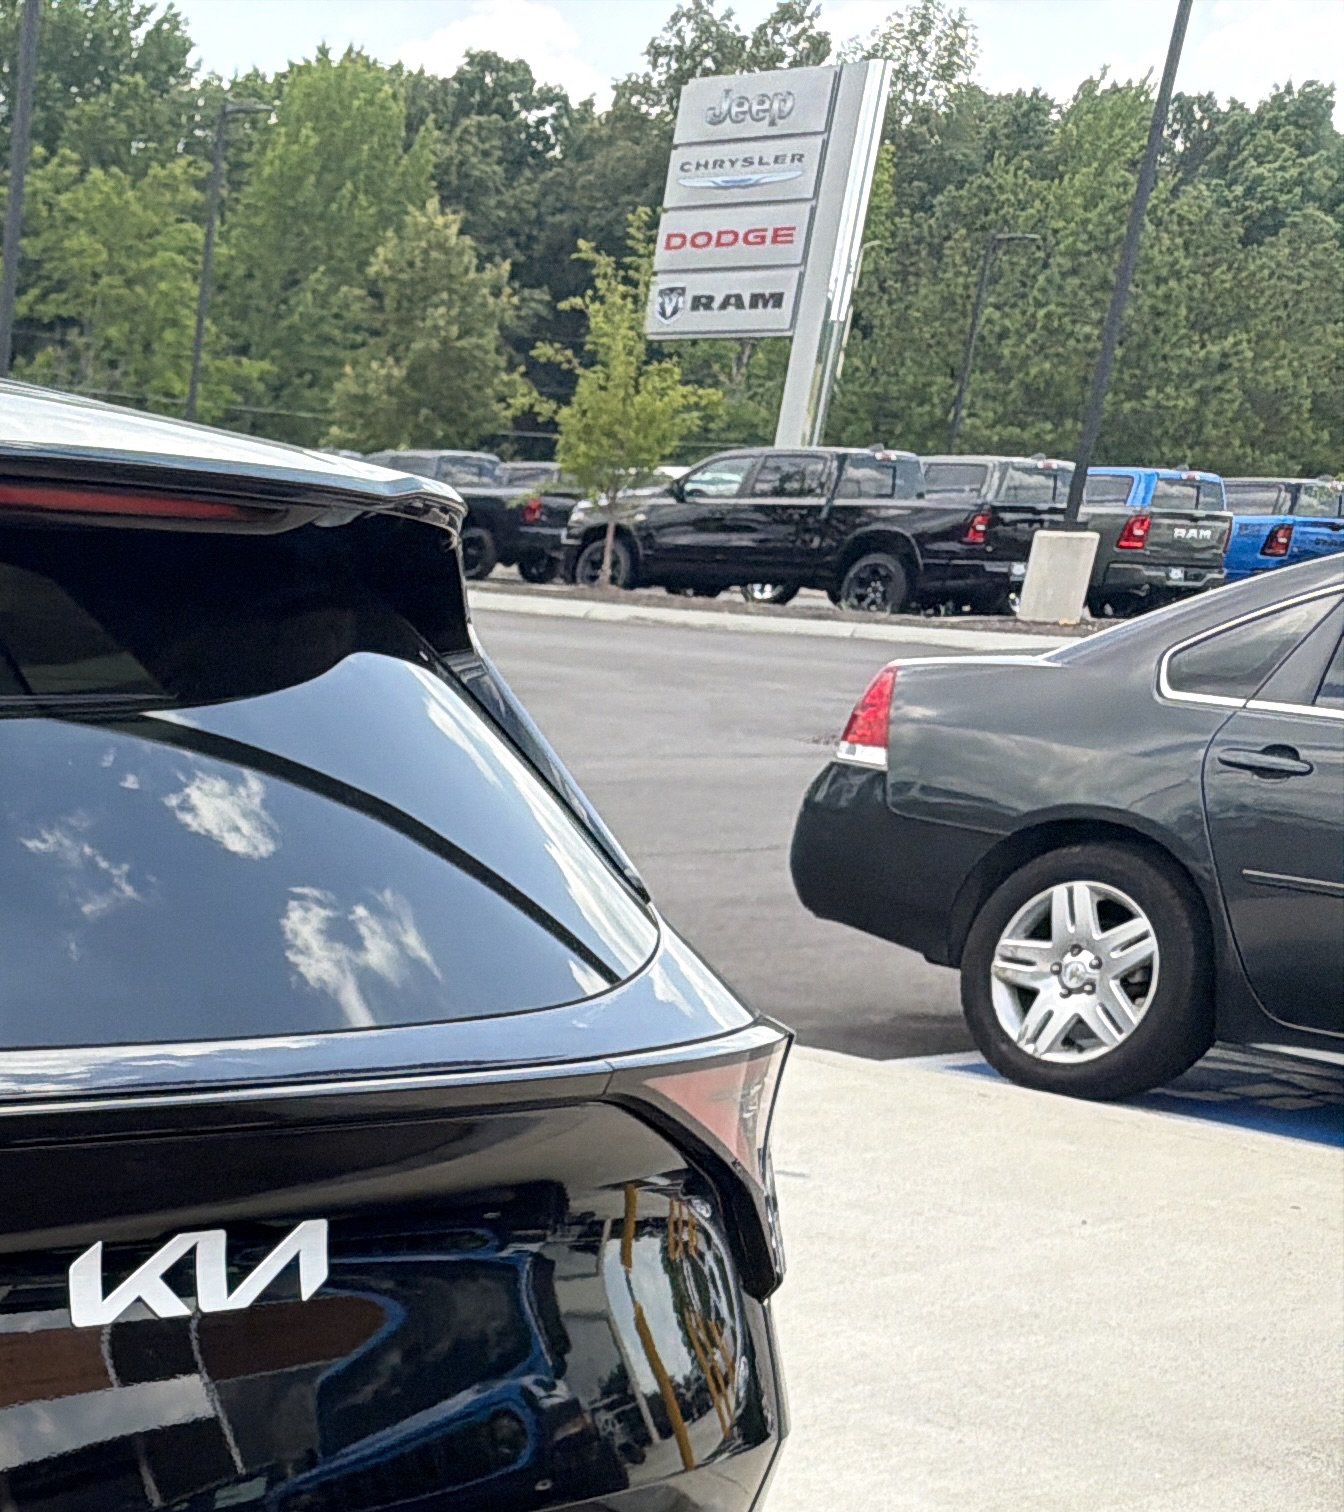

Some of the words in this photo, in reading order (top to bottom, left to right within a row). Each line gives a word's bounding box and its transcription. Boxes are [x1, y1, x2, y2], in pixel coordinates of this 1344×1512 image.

[705, 88, 795, 126] Jeep
[679, 152, 805, 173] CHRYSLER
[664, 226, 797, 250] DODGE
[690, 291, 785, 312] RAM
[1173, 528, 1212, 539] RAM
[69, 1218, 328, 1328] KIA
